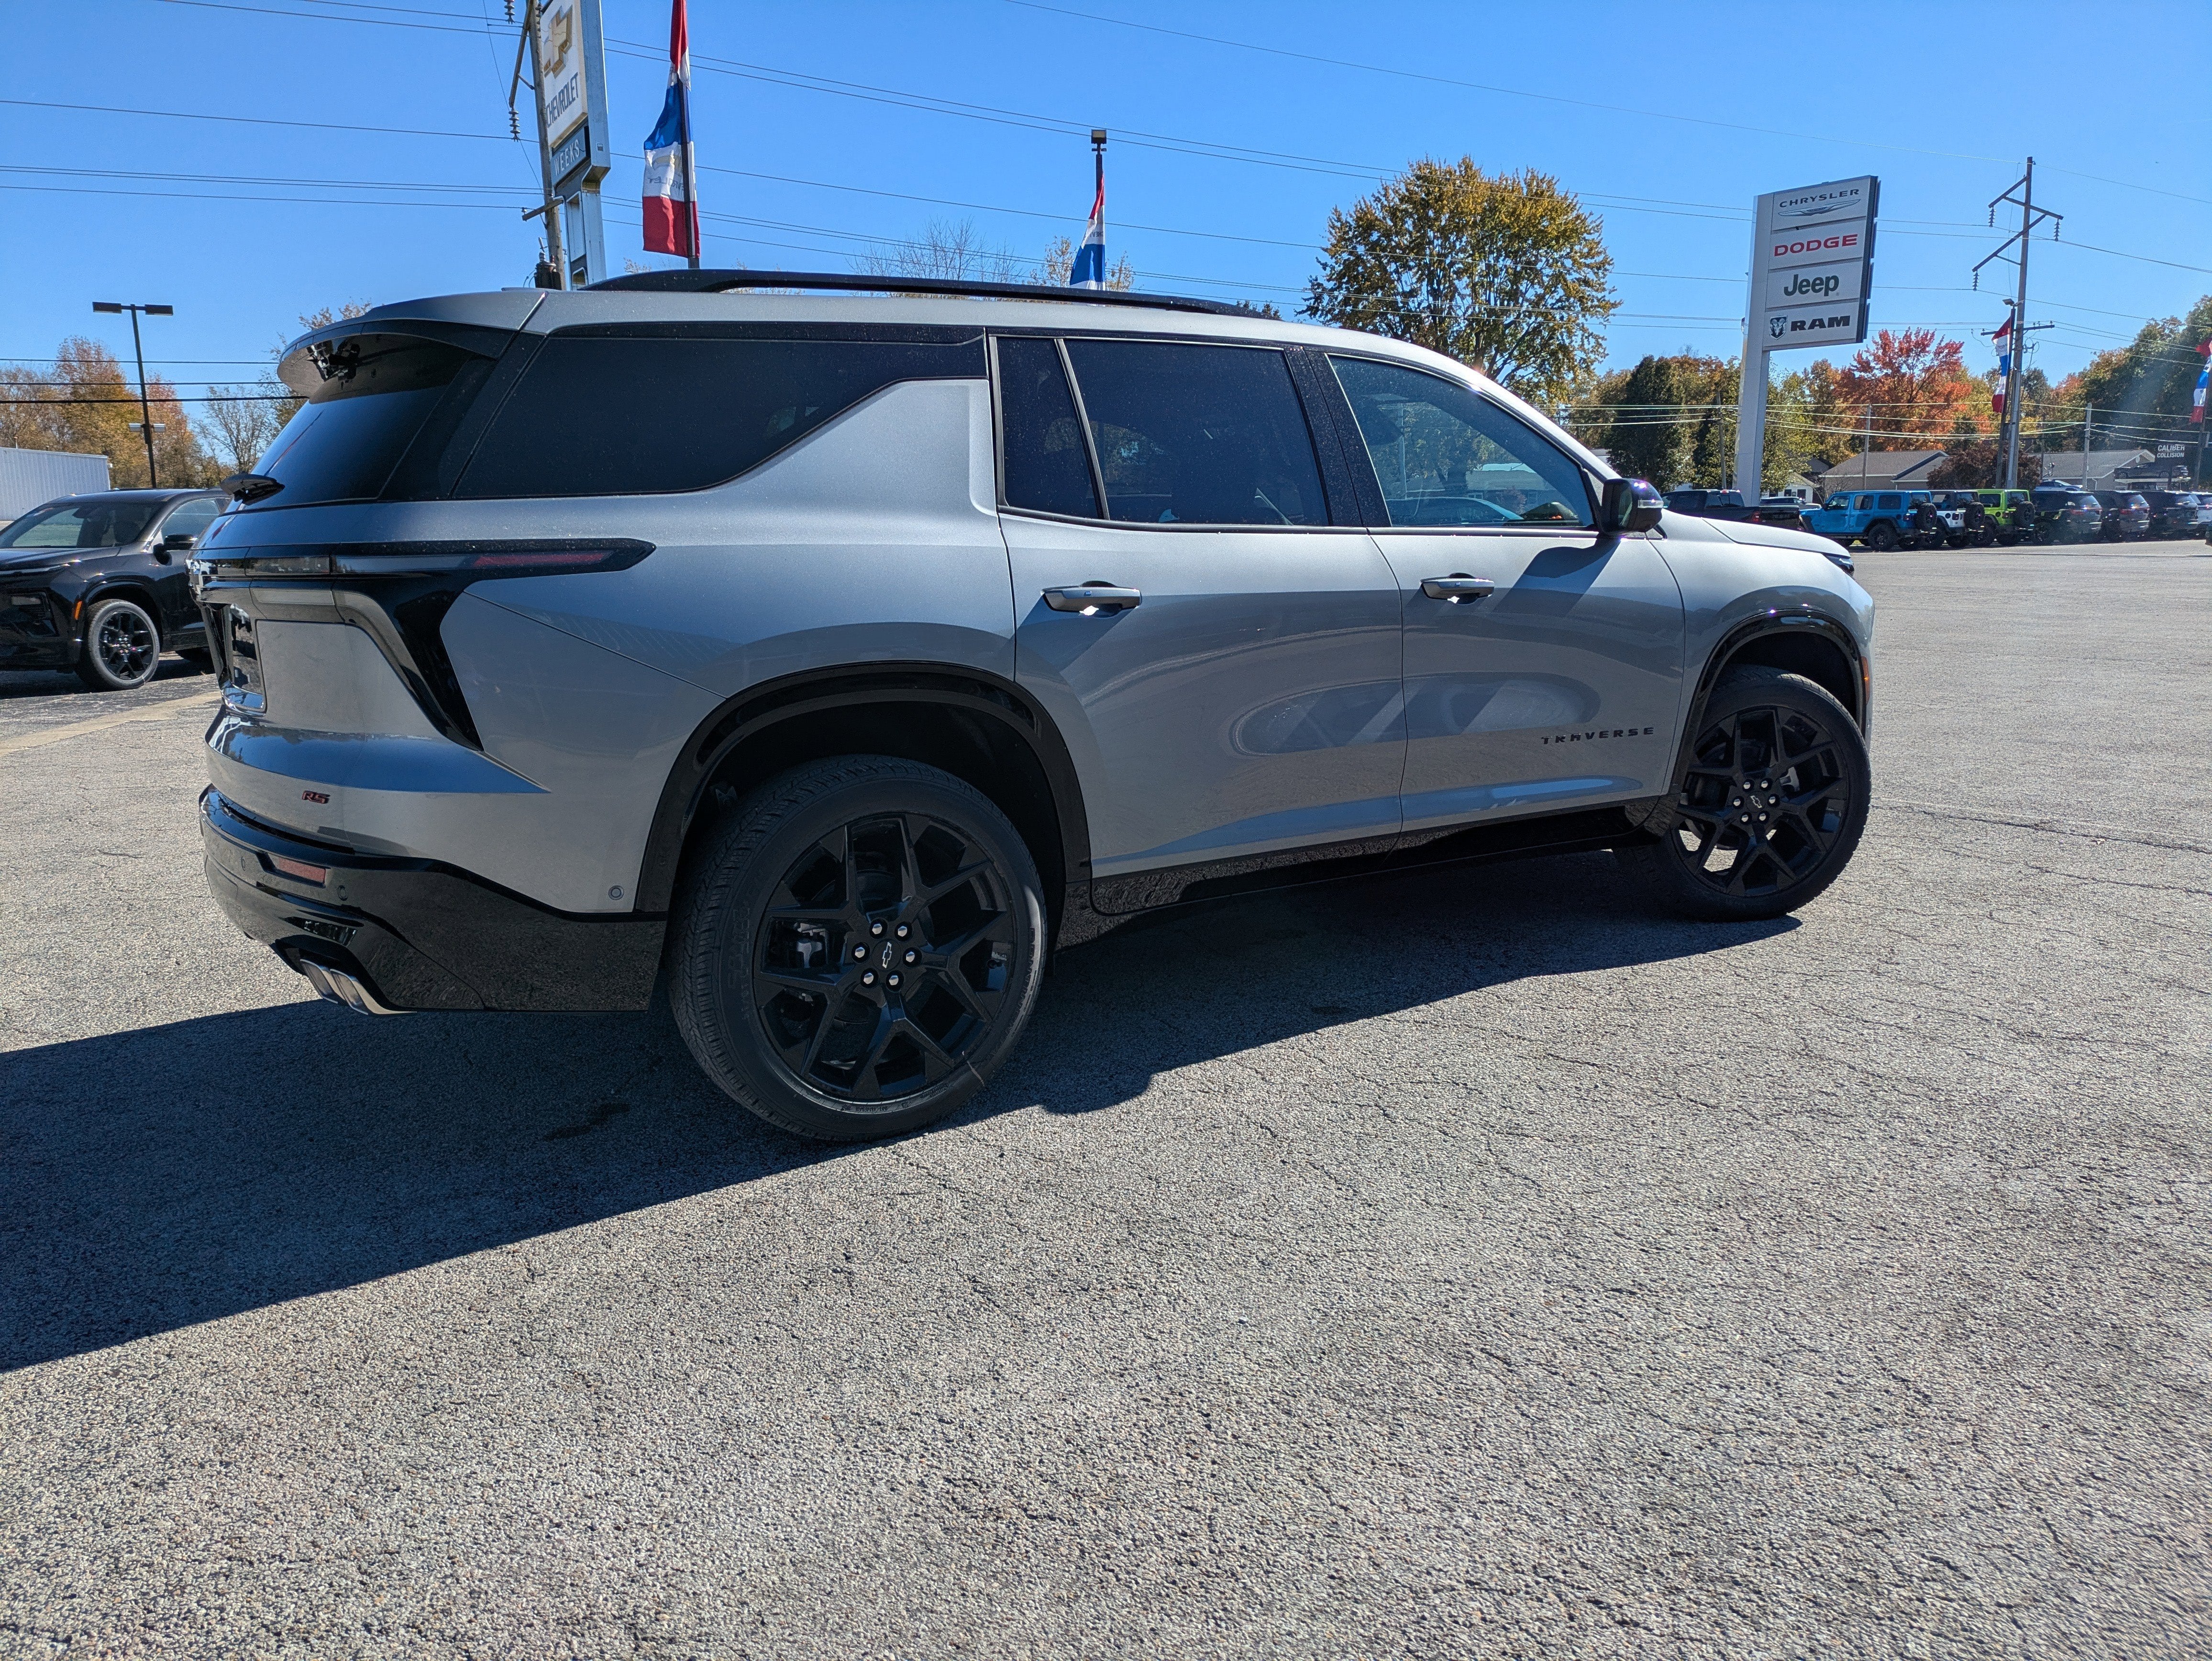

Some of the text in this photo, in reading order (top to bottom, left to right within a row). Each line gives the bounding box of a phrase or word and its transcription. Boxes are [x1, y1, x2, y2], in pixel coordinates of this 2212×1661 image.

[546, 72, 579, 128] CHEVROLET
[554, 139, 580, 176] WEEKS
[1779, 188, 1859, 208] CHRYSLER
[1774, 234, 1858, 257] DODGE
[1783, 274, 1839, 297] Jeep
[1790, 315, 1851, 332] RAM
[1541, 727, 1654, 744] TRAVERSE
[301, 790, 330, 804] RS
